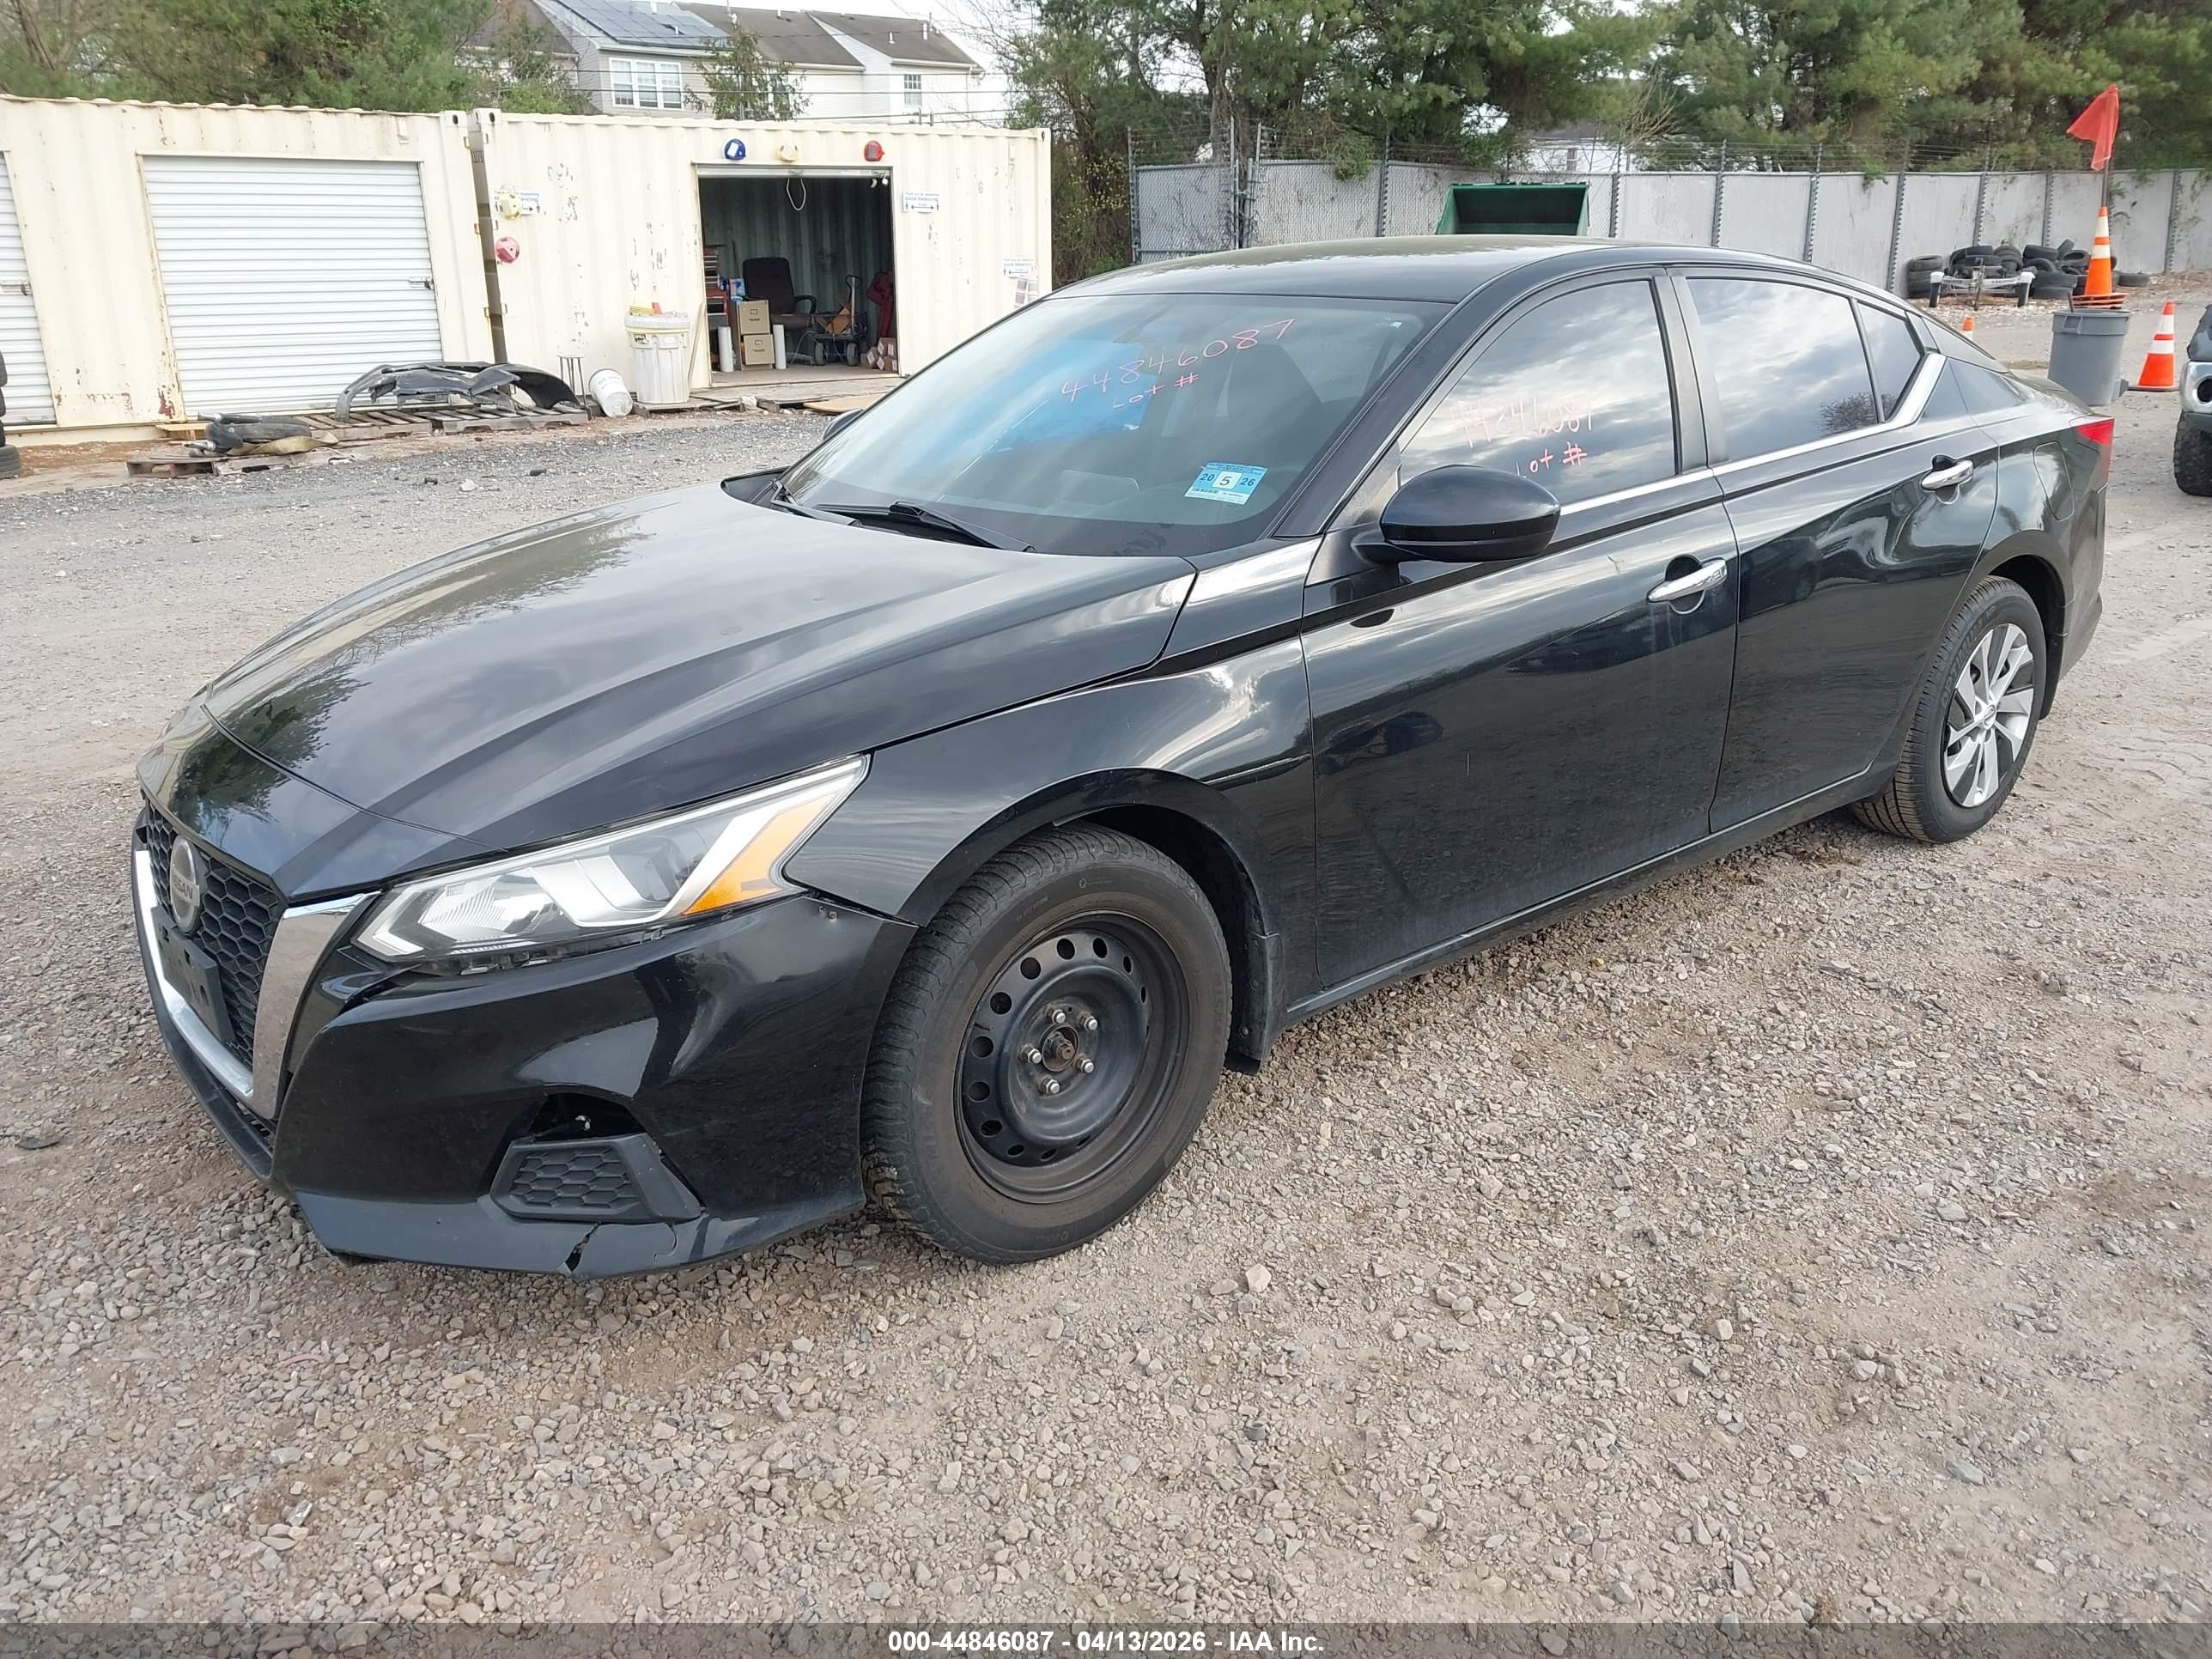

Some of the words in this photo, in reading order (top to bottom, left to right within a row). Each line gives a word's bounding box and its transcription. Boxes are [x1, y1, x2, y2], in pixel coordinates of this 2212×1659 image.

[1061, 318, 1296, 403] 44846087
[1113, 385, 1165, 409] Lot
[1174, 372, 1200, 387] #
[1562, 441, 1588, 467] #
[1200, 473, 1215, 482] 20
[1218, 476, 1233, 487] 5
[1240, 477, 1255, 487] 26
